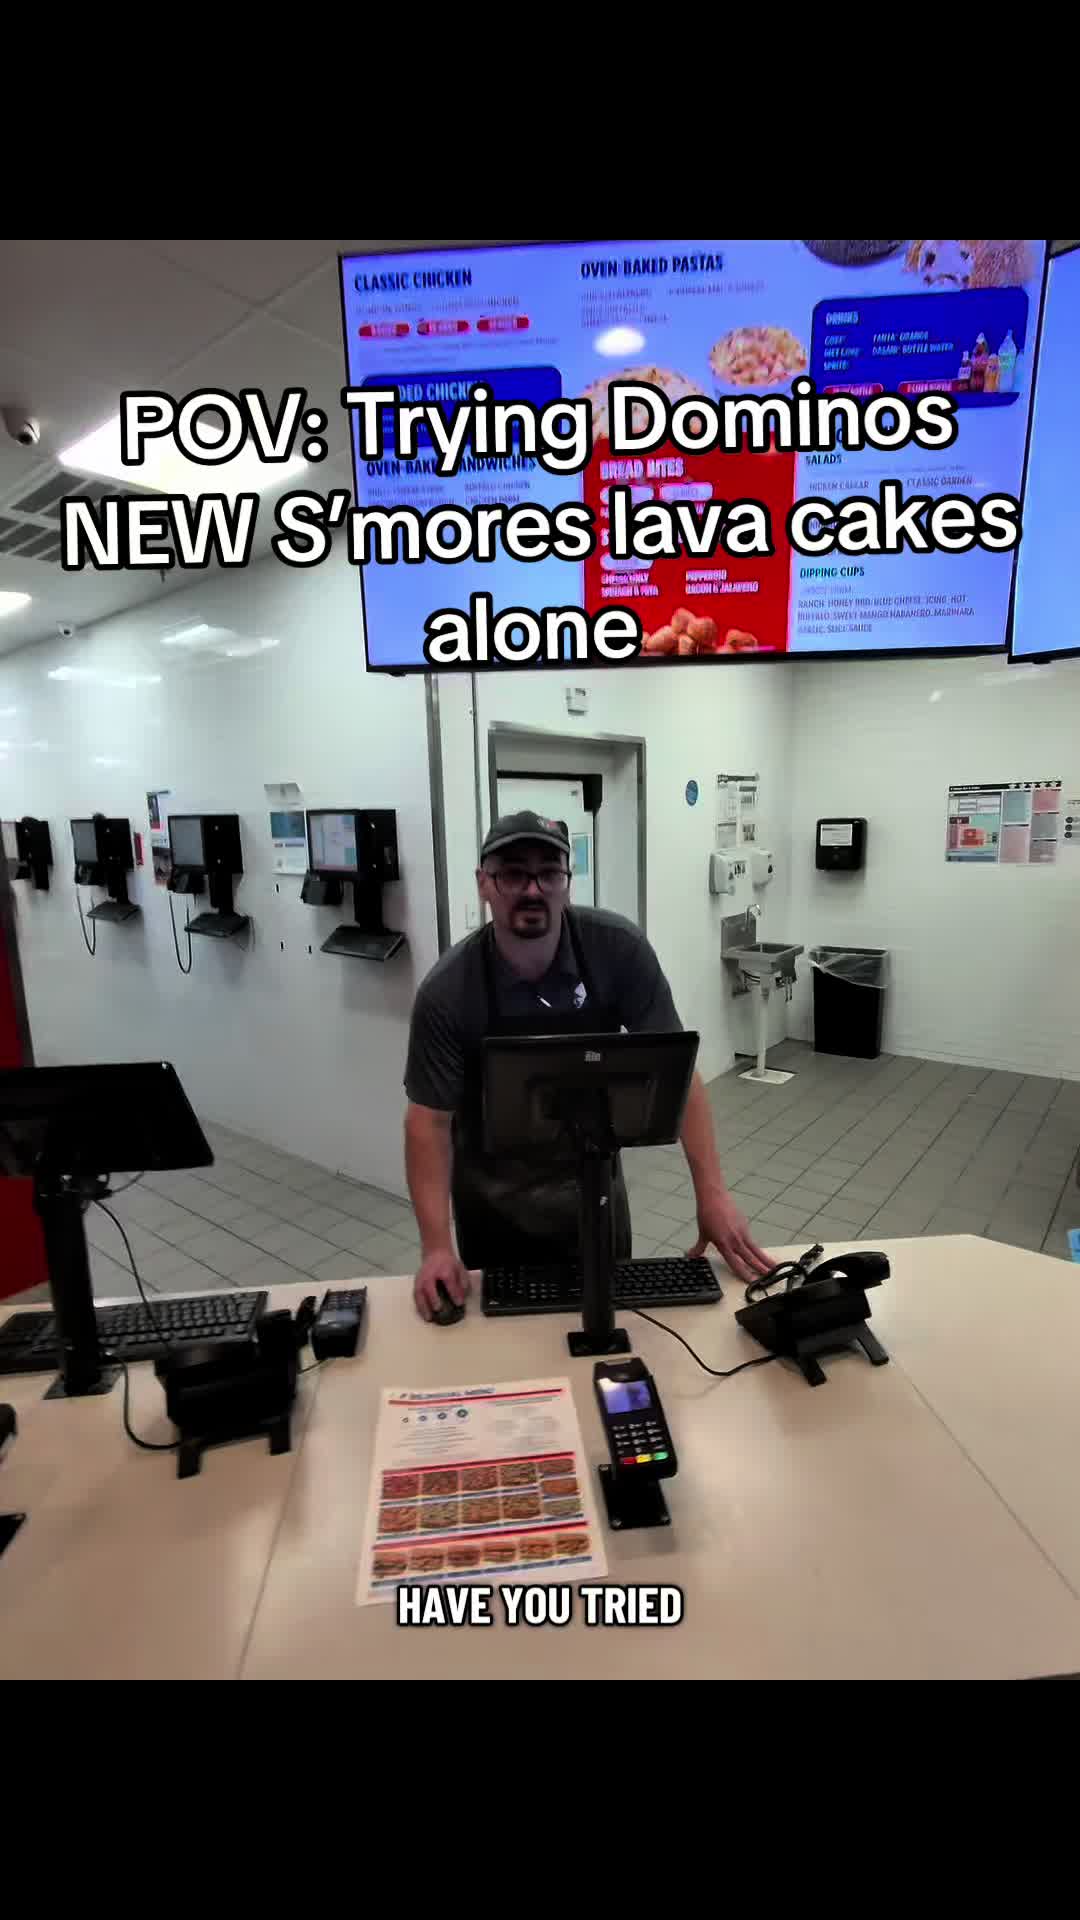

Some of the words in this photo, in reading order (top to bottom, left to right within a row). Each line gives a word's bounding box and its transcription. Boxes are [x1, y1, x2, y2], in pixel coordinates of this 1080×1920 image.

[672, 253, 724, 274] PASTAS
[354, 272, 409, 293] CLASSIC
[413, 268, 472, 290] CHICKEN
[459, 454, 537, 473] ANDWICHES
[805, 454, 842, 466] SALADS
[799, 567, 838, 579] DIPPING
[840, 566, 865, 577] CUPS
